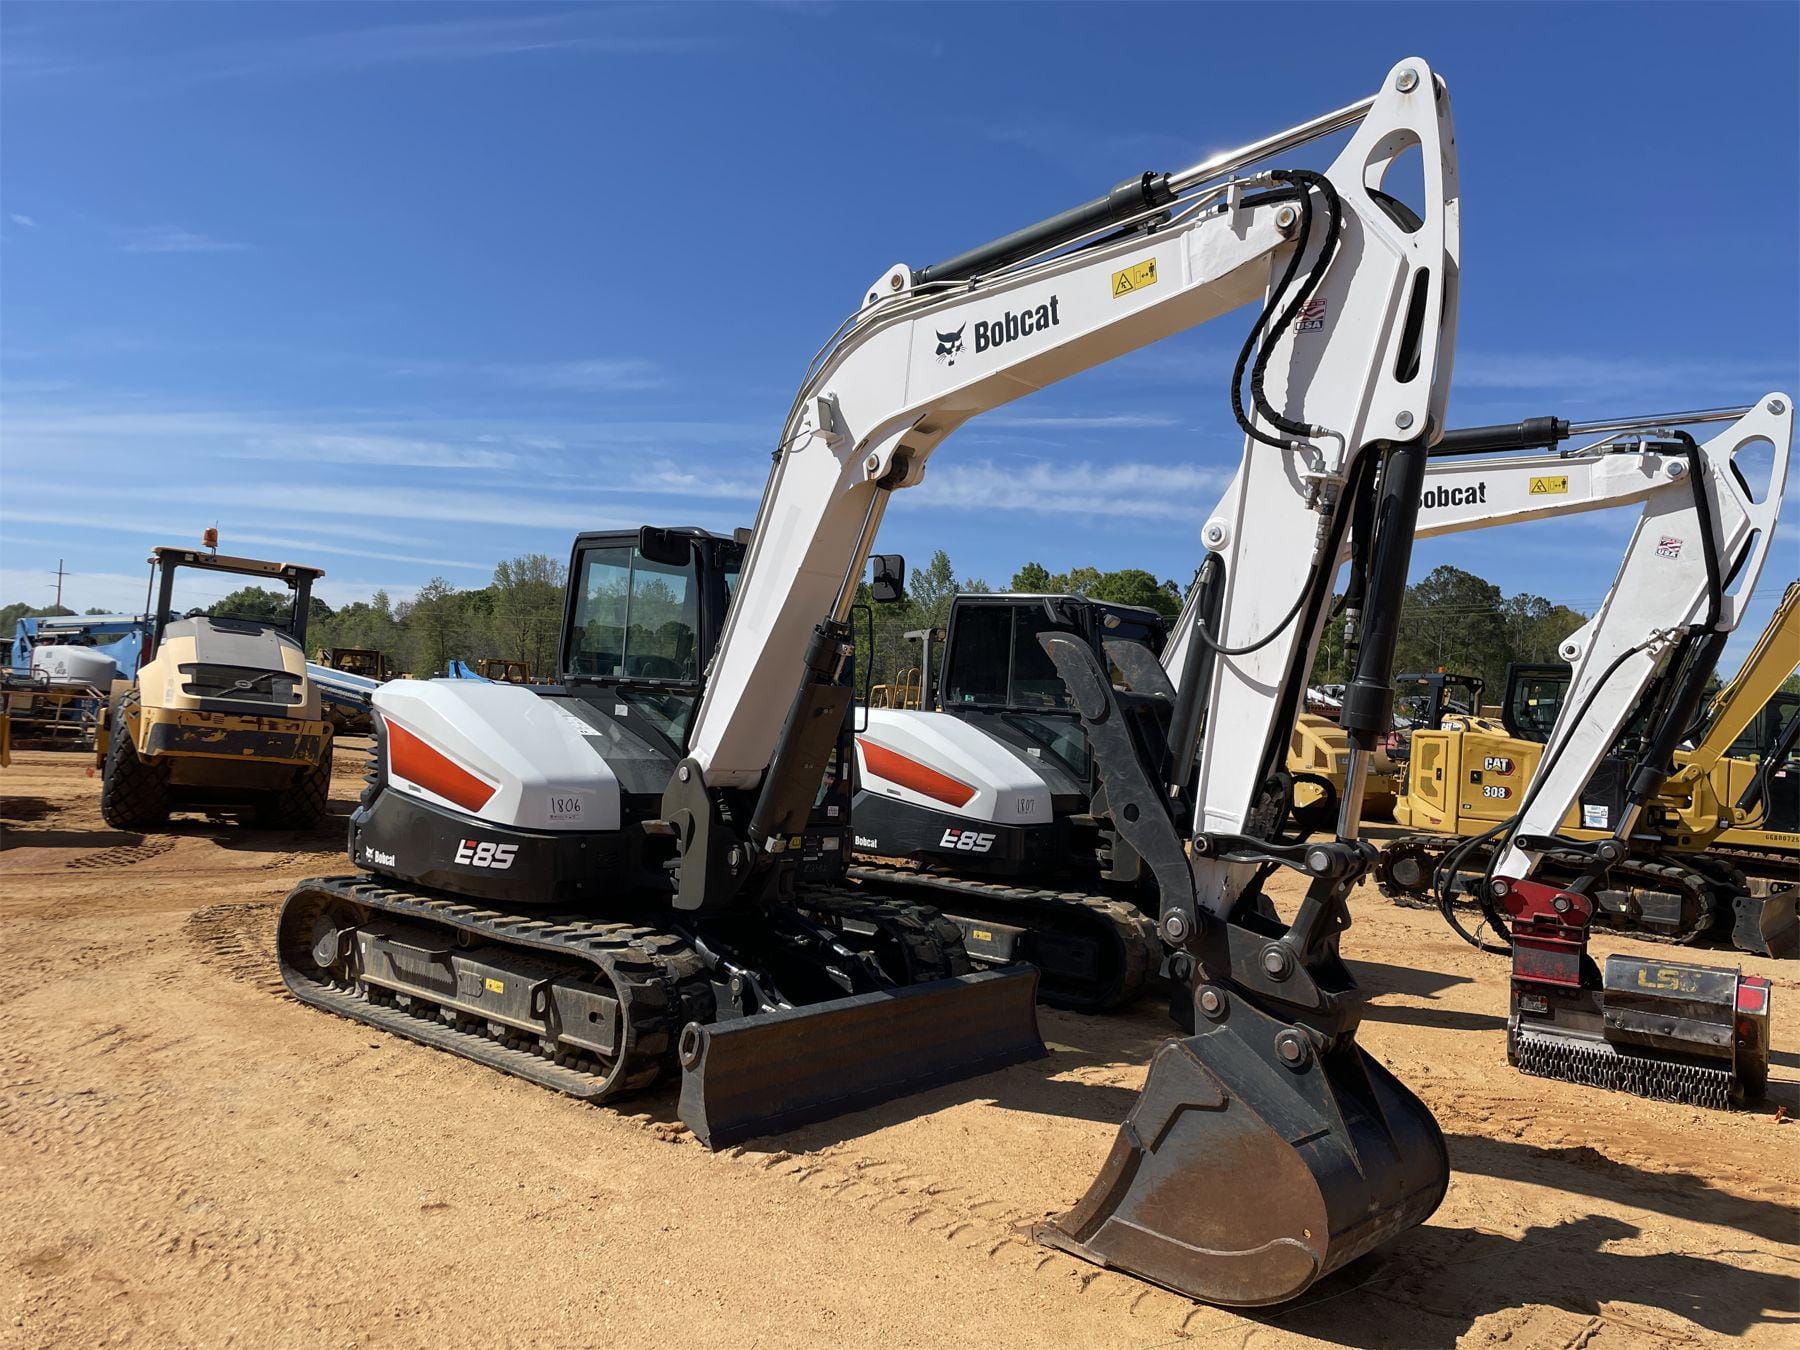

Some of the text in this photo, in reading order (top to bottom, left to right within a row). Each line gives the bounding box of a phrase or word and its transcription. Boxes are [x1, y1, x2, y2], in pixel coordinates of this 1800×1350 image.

[975, 295, 1059, 353] Bobcat
[1296, 320, 1322, 330] USA
[1420, 482, 1486, 508] obcat
[1484, 757, 1508, 771] CAT
[1484, 786, 1505, 798] 308
[551, 797, 581, 814] 1806
[855, 835, 877, 849] Bobcat
[939, 828, 997, 852] E85
[374, 850, 395, 867] Bobcat
[454, 839, 519, 870] E85
